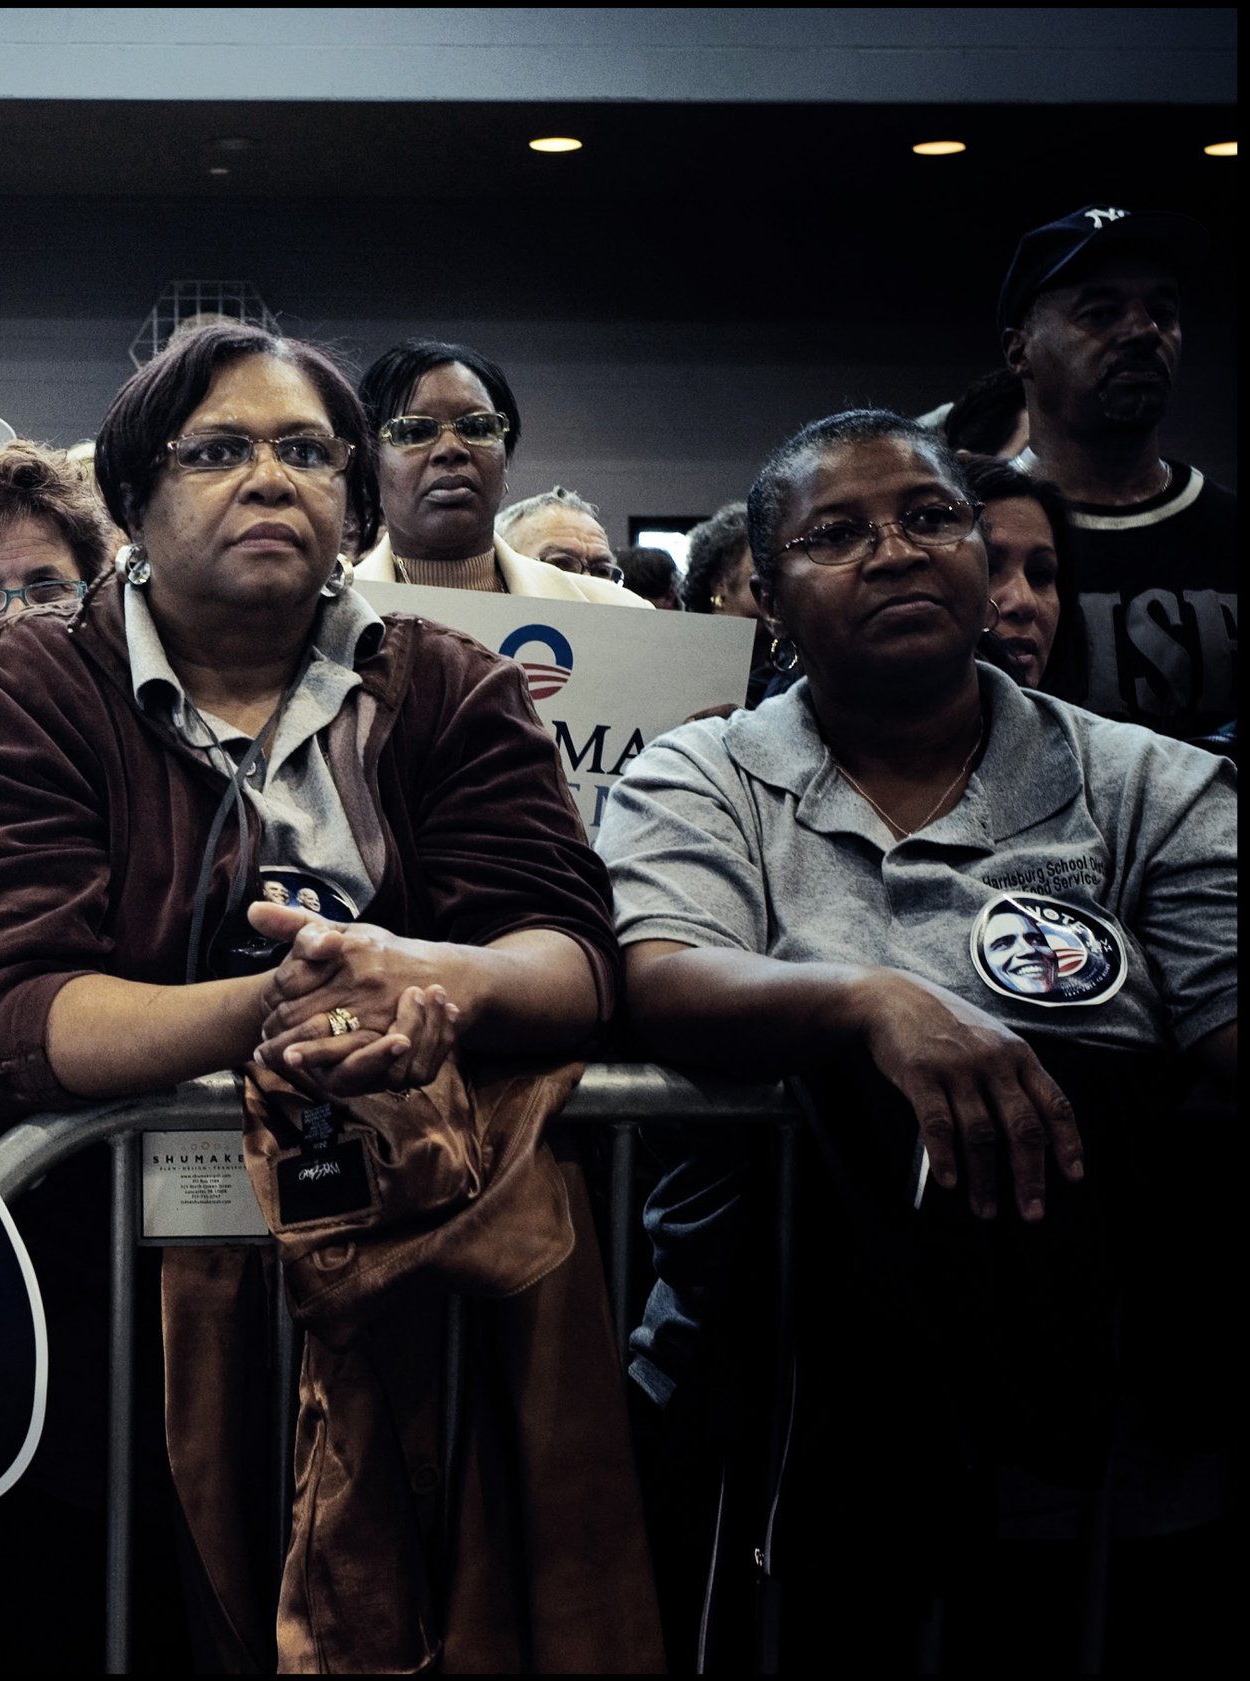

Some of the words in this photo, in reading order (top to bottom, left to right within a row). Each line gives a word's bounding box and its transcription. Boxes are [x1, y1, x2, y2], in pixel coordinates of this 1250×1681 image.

[1046, 855, 1088, 877] School
[1052, 870, 1102, 892] Service
[152, 1153, 244, 1164] SHUMAKE
